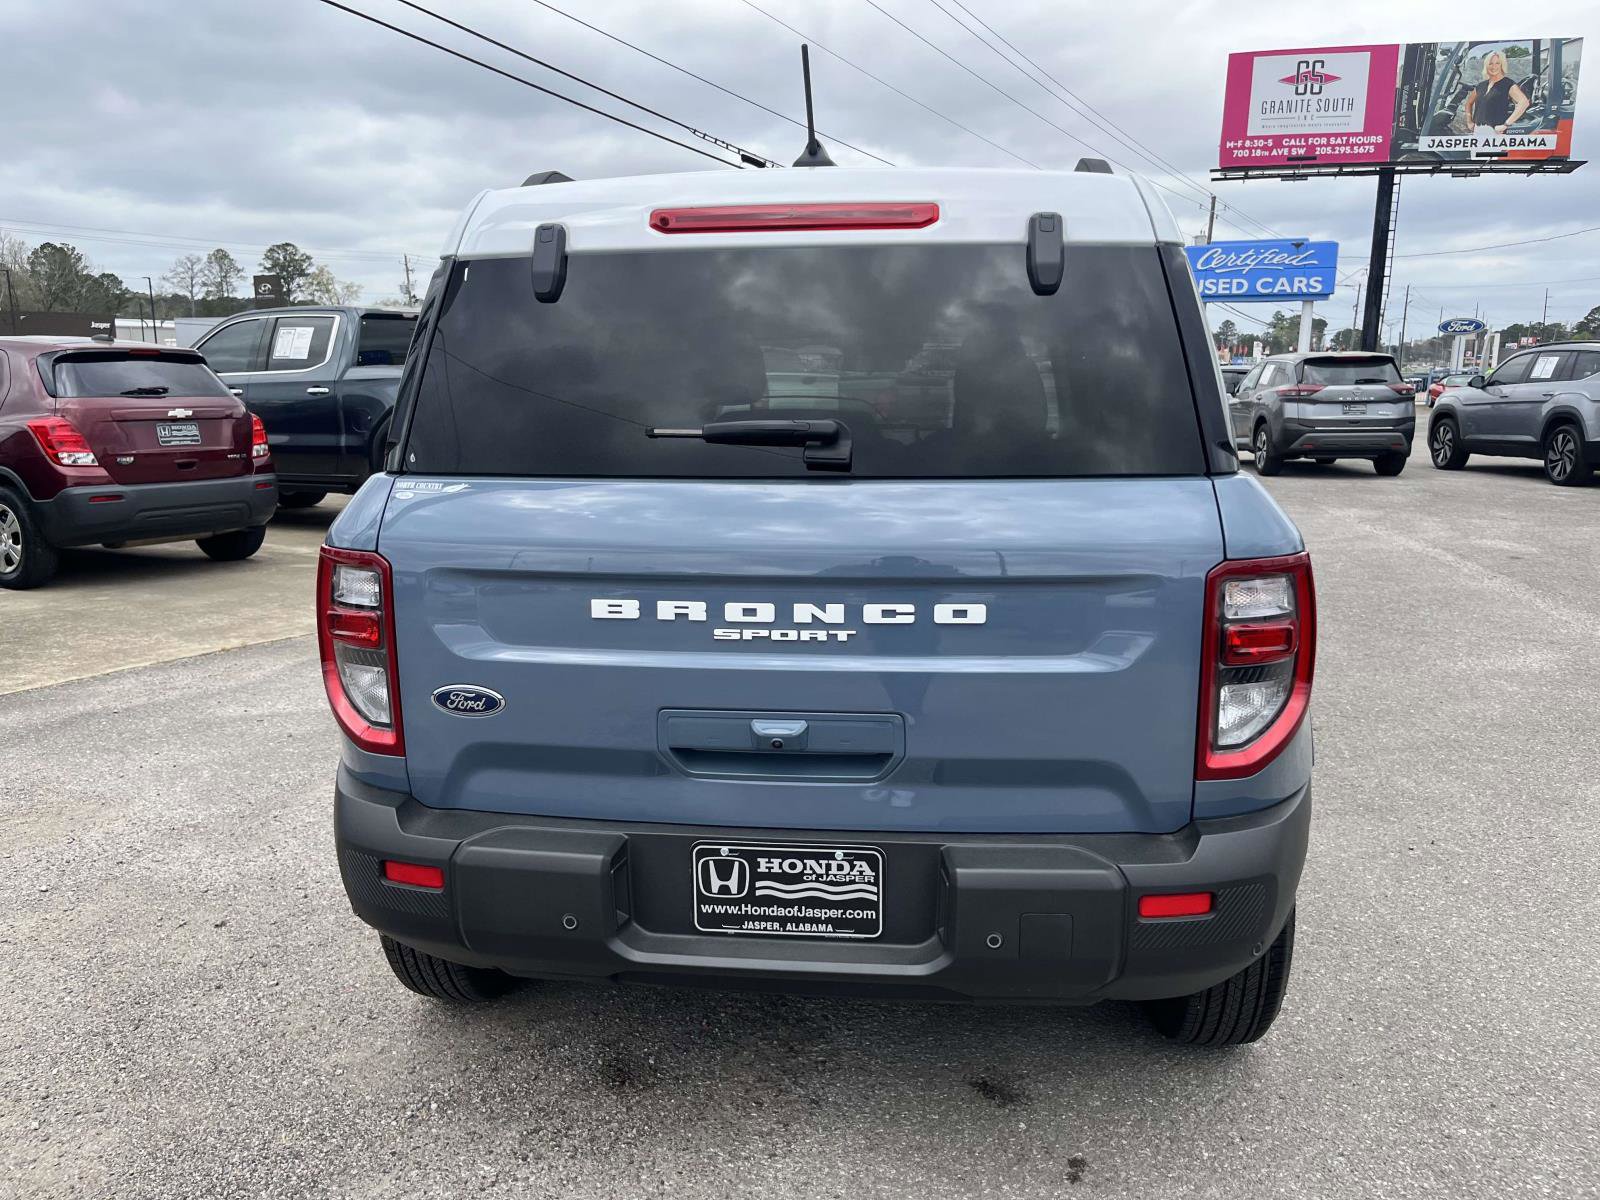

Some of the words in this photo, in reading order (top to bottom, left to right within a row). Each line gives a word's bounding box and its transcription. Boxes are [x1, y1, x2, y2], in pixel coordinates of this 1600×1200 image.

[1295, 59, 1325, 95] GS
[1261, 98, 1312, 115] GRANITE
[1316, 97, 1354, 112] SOUTH
[1226, 140, 1243, 149] M-F
[1244, 138, 1273, 148] 8:30-5
[1282, 137, 1306, 146] CALL
[1308, 137, 1327, 146] FOR
[1329, 136, 1347, 145] SAT
[1349, 135, 1383, 144] HOURS
[1427, 138, 1478, 149] JASPER
[1482, 137, 1547, 148] ALABAMA
[1232, 149, 1249, 158] 700
[1271, 148, 1289, 156] AVE
[1291, 147, 1306, 155] SW
[1315, 145, 1375, 155] 205.295.5675
[1196, 247, 1319, 275] Certified
[1255, 276, 1323, 294] CARS
[1447, 321, 1476, 332] Ford
[590, 598, 988, 625] BRONCO
[713, 627, 857, 642] SPORT
[447, 691, 486, 711] Ford
[756, 857, 876, 876] HONDA
[803, 873, 816, 881] of
[819, 874, 876, 883] JASPER
[701, 903, 877, 921] www.HondaofJasper.com
[742, 920, 783, 932] JASPER,
[785, 922, 834, 933] ALABAMA
